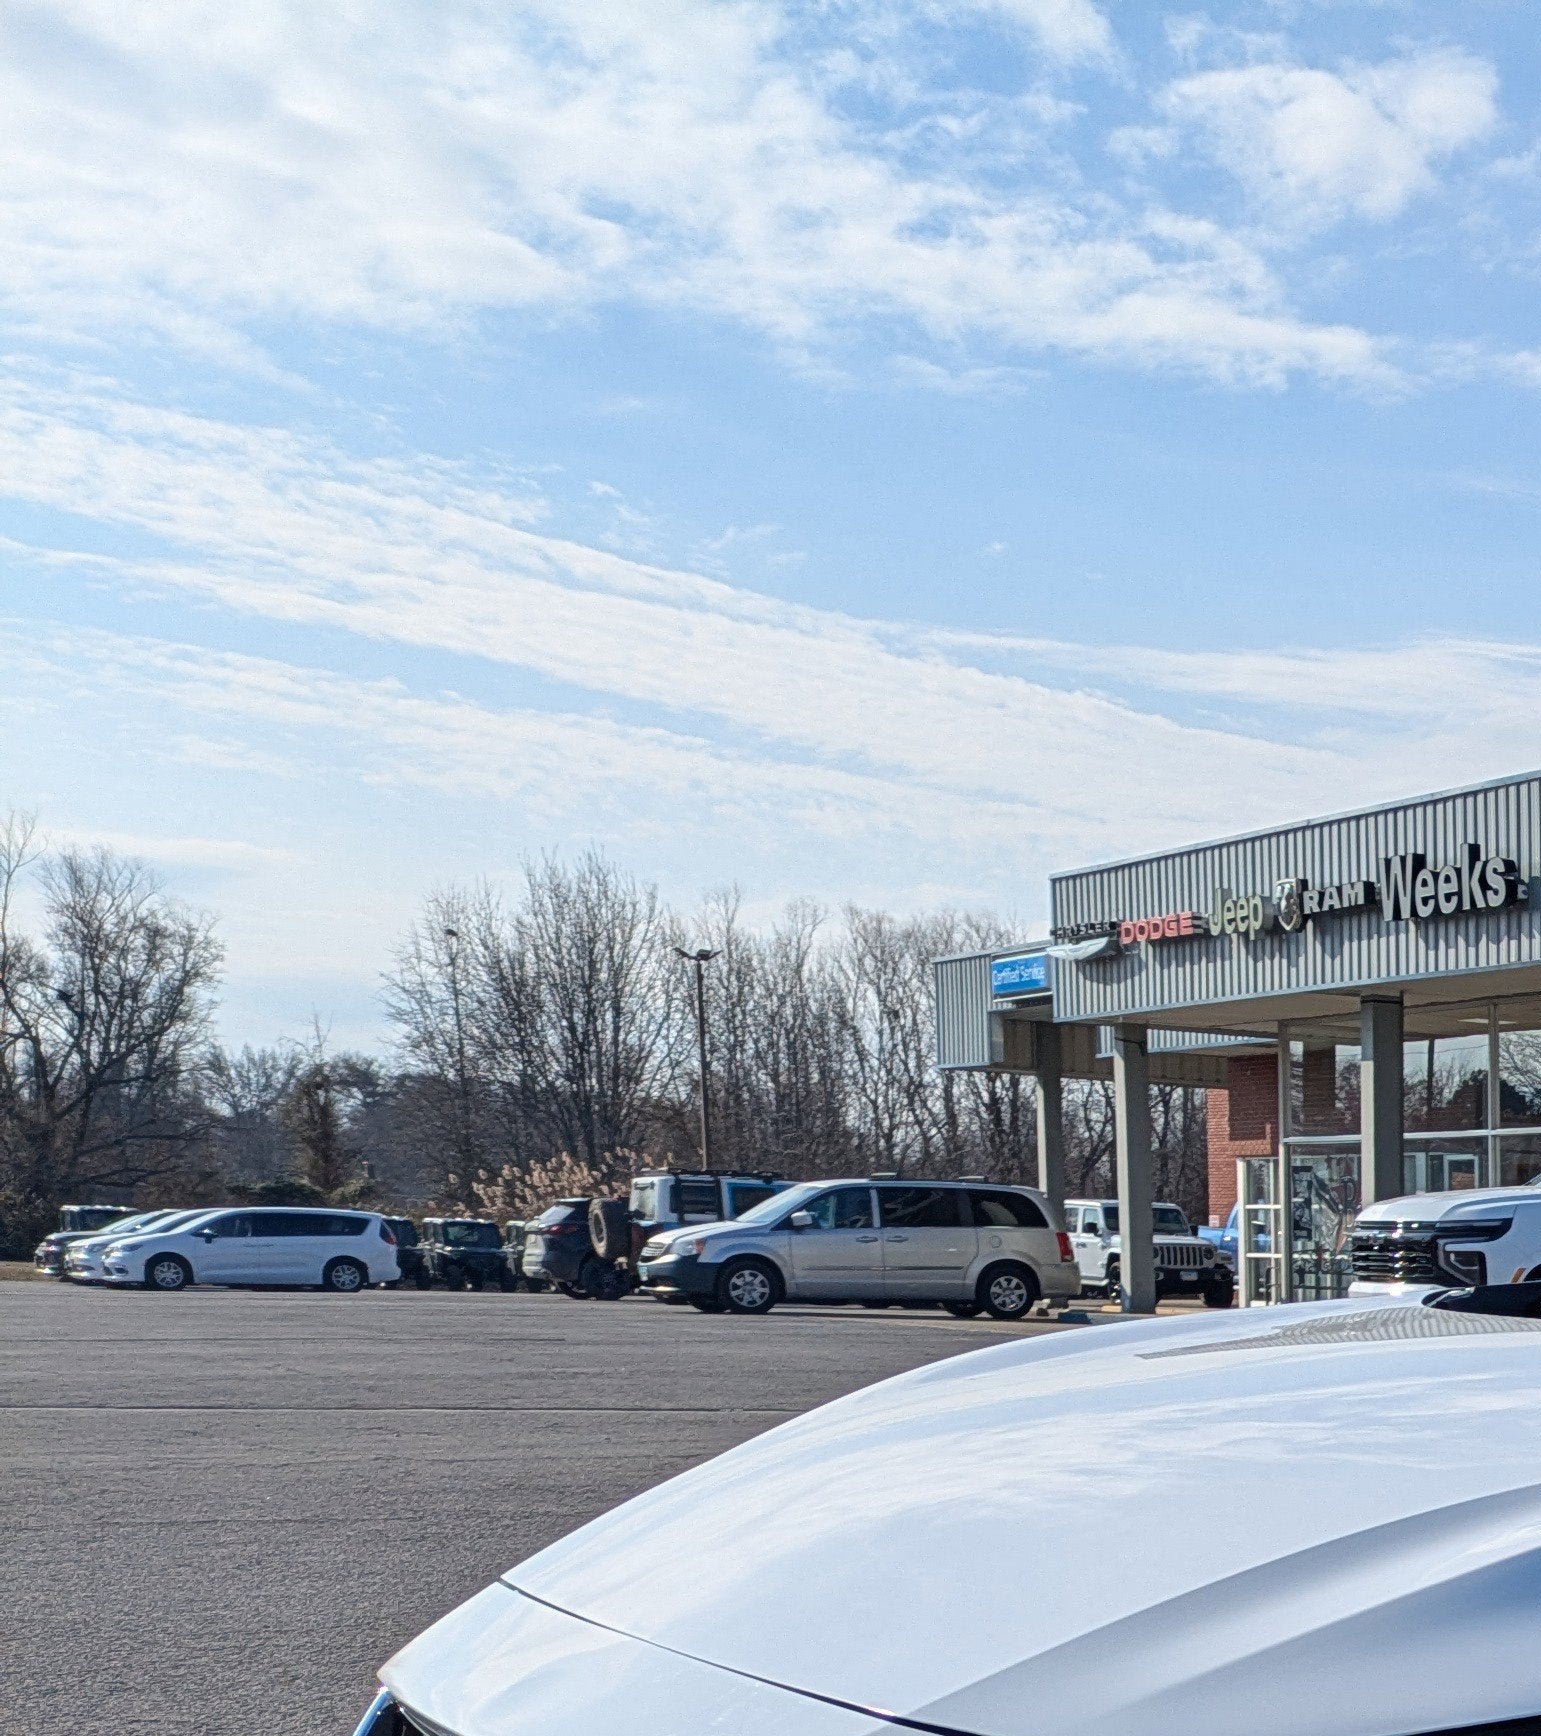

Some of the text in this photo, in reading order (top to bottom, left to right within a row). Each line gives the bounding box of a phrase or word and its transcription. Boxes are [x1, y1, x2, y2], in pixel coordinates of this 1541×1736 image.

[1120, 911, 1194, 945] DODGE
[1208, 887, 1263, 941] Jeep
[1303, 880, 1365, 915] RAM
[1378, 842, 1507, 922] Weeks
